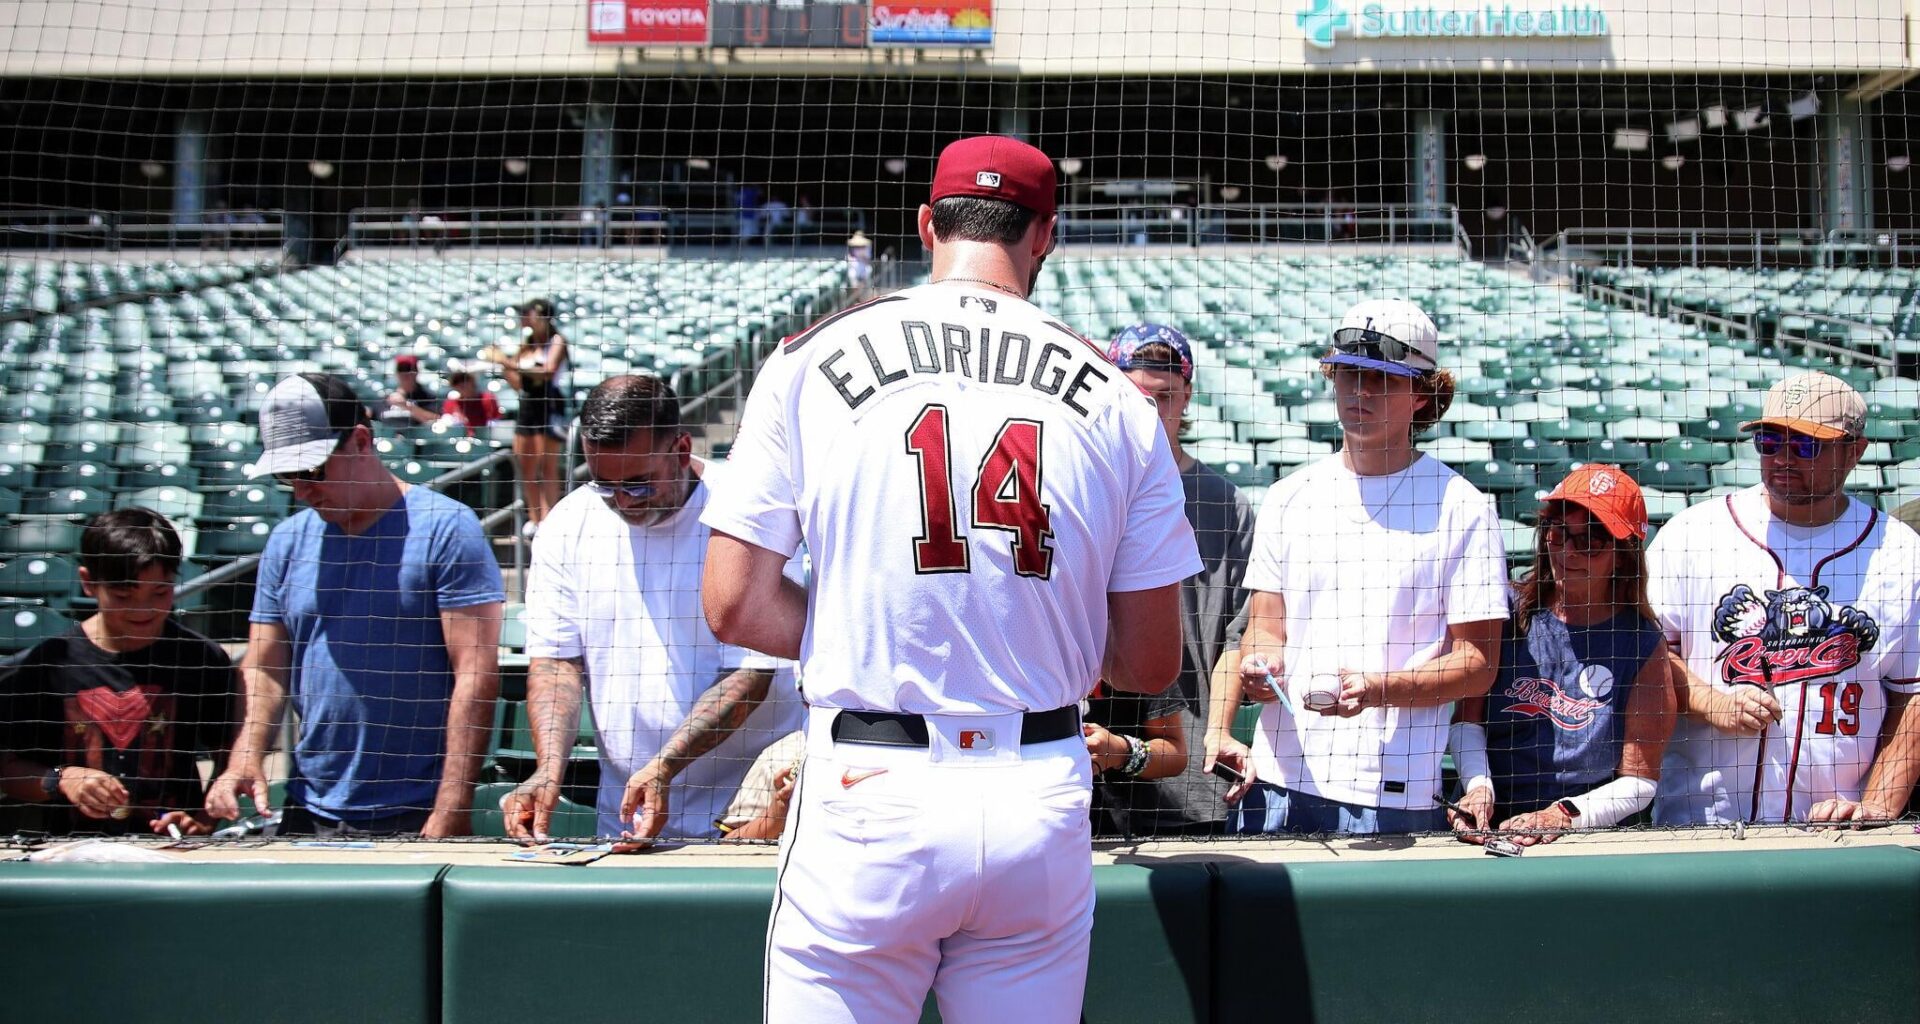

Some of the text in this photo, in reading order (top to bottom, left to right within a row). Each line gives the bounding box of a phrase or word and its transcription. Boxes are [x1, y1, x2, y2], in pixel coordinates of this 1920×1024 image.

[630, 8, 706, 26] TOYOTA
[1361, 3, 1608, 35] Sutter Health
[818, 320, 1110, 419] ELDRIDGE
[905, 403, 1056, 581] 14
[1766, 636, 1826, 648] SACRAMENTO
[1815, 681, 1864, 736] 19
